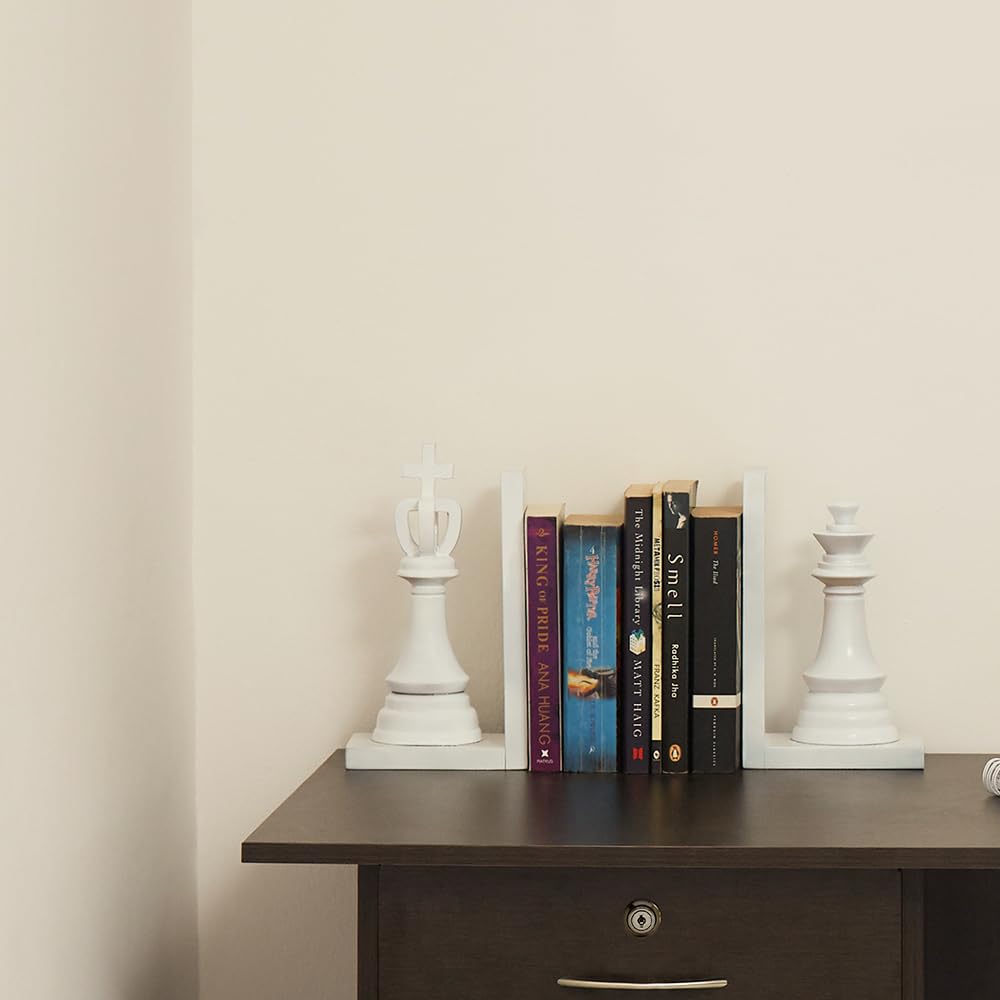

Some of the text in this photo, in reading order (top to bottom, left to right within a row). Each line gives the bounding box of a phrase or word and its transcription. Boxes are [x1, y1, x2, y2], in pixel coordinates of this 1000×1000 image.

[536, 546, 549, 586] KING
[632, 509, 644, 626] The Midnight Library
[666, 554, 684, 619] Smell
[536, 607, 549, 653] PRIDE
[538, 662, 551, 745] ANA HUANG
[633, 660, 642, 738] MATT HAIG
[671, 644, 680, 698] Radhika Jha
